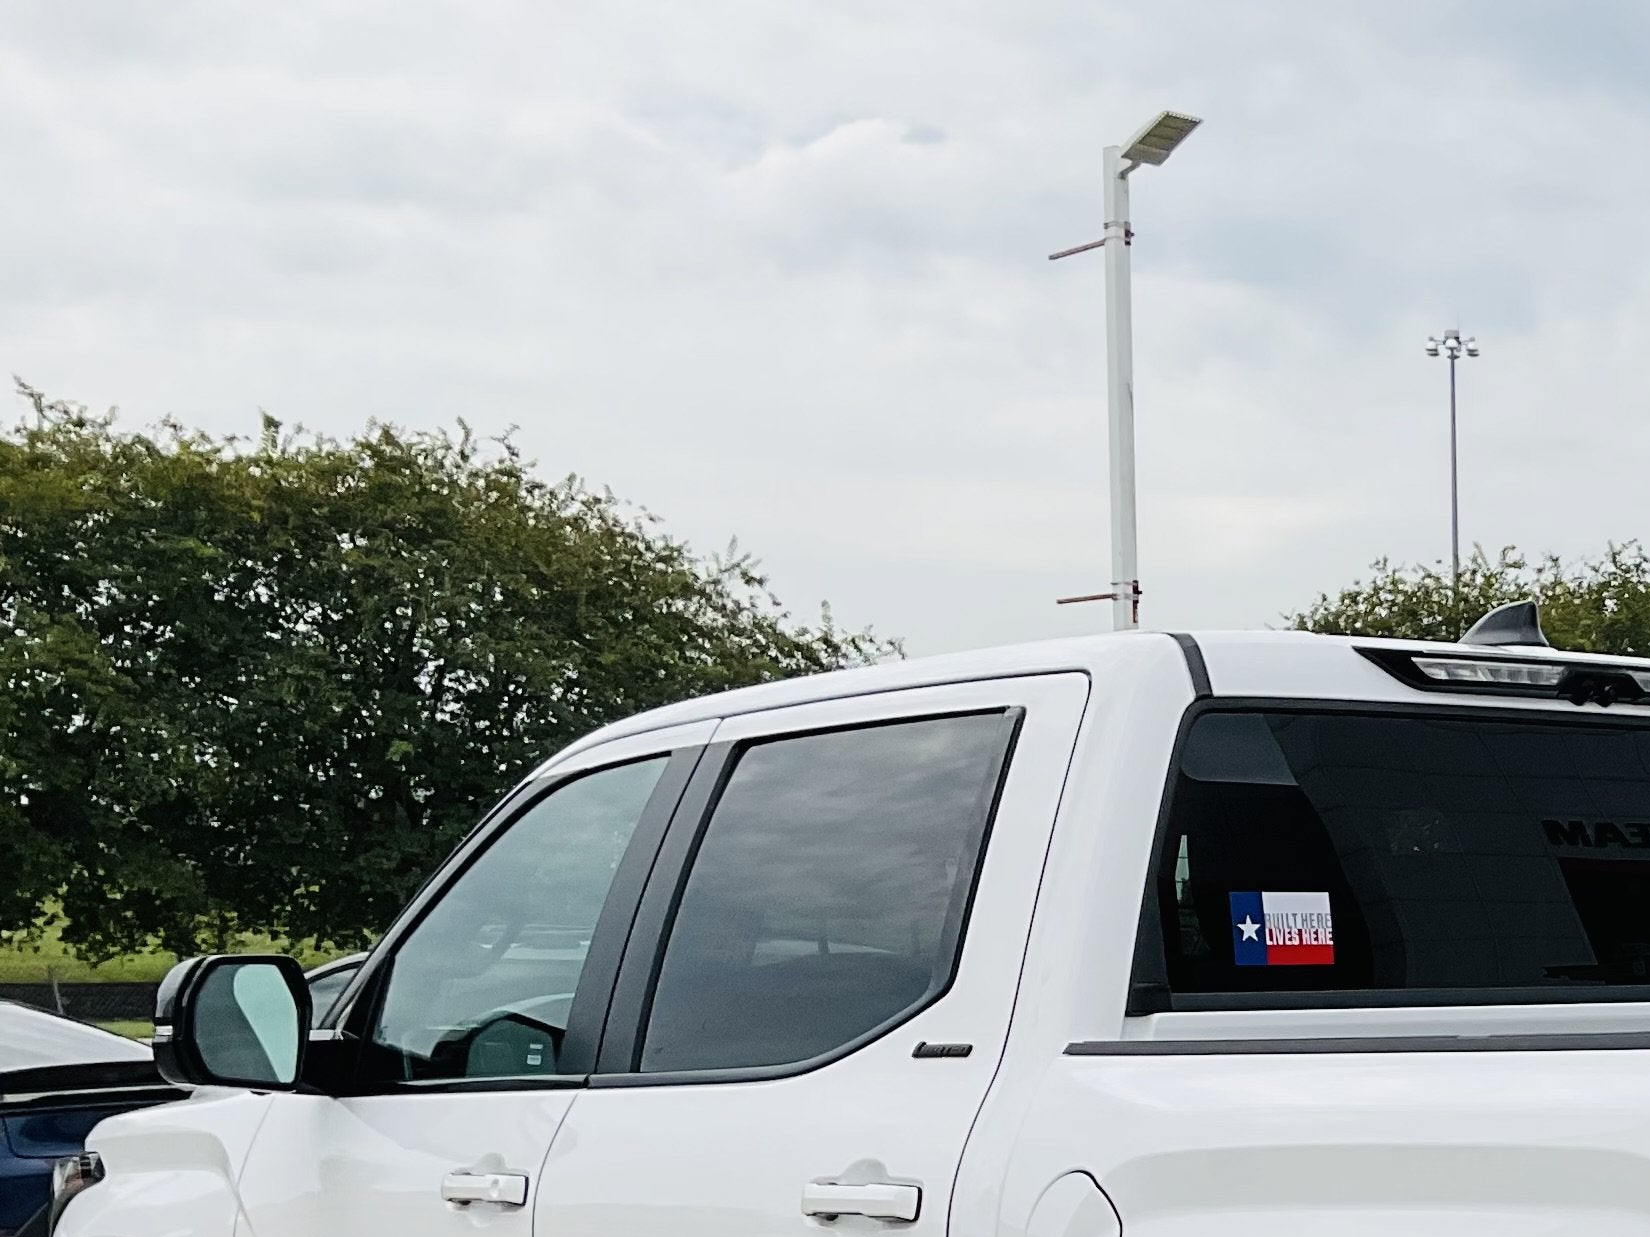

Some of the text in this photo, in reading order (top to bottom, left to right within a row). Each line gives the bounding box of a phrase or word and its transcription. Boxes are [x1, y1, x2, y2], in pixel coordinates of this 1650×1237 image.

[1264, 912, 1332, 929] BUILT HERE
[1265, 928, 1334, 946] LIVES HERE
